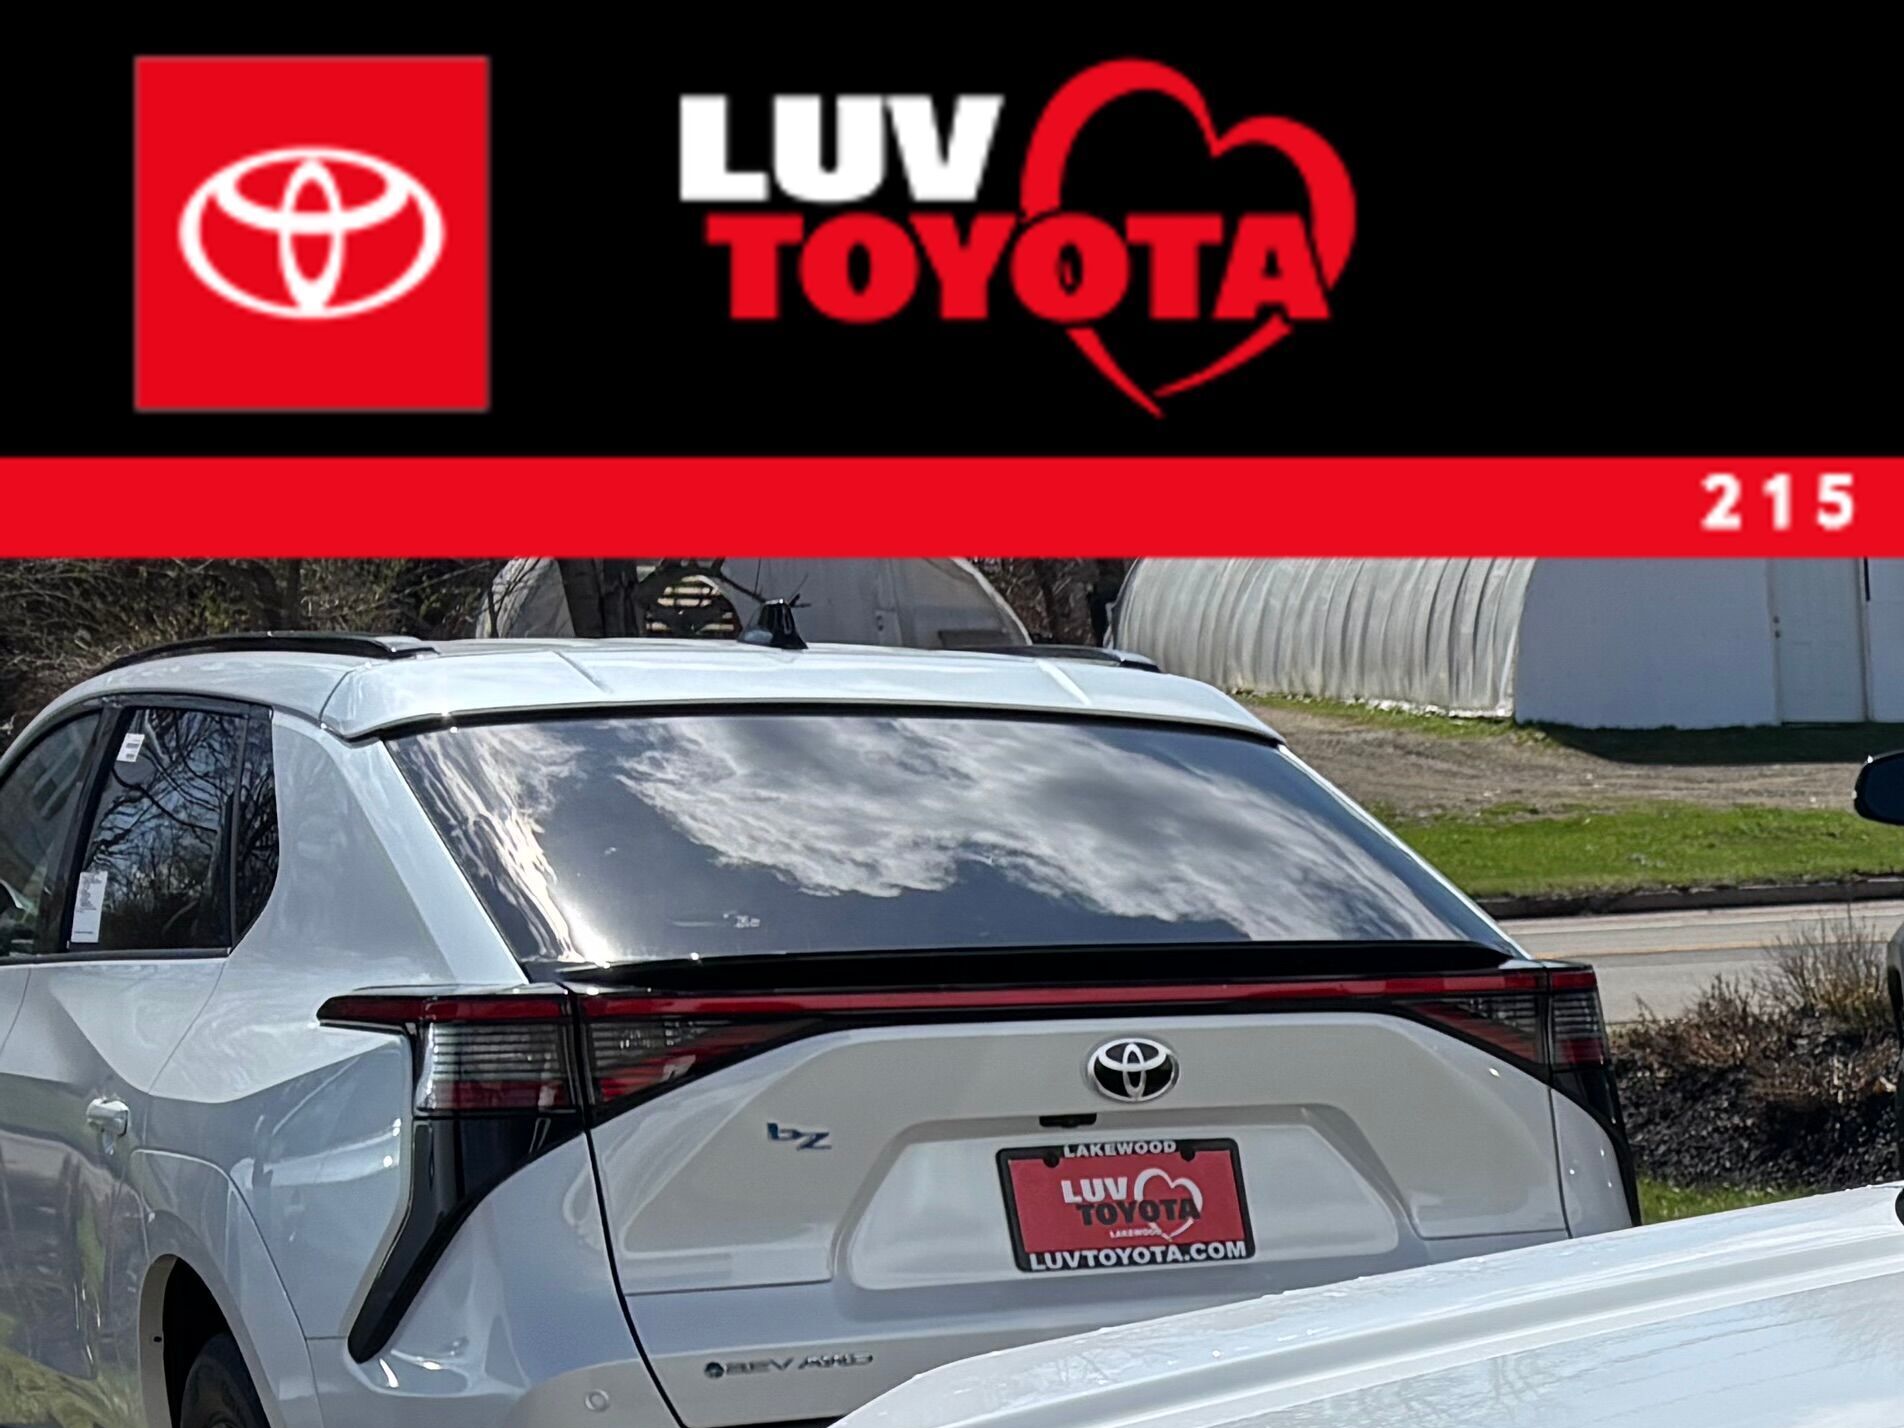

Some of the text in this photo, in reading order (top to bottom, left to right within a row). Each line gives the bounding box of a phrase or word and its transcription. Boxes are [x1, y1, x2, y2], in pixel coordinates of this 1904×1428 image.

[1063, 1140, 1177, 1159] LAKEWOOD
[1061, 1176, 1128, 1204] LUV
[1076, 1198, 1202, 1227] TOYOTA
[1029, 1240, 1248, 1272] LUVTOYOTA.COM
